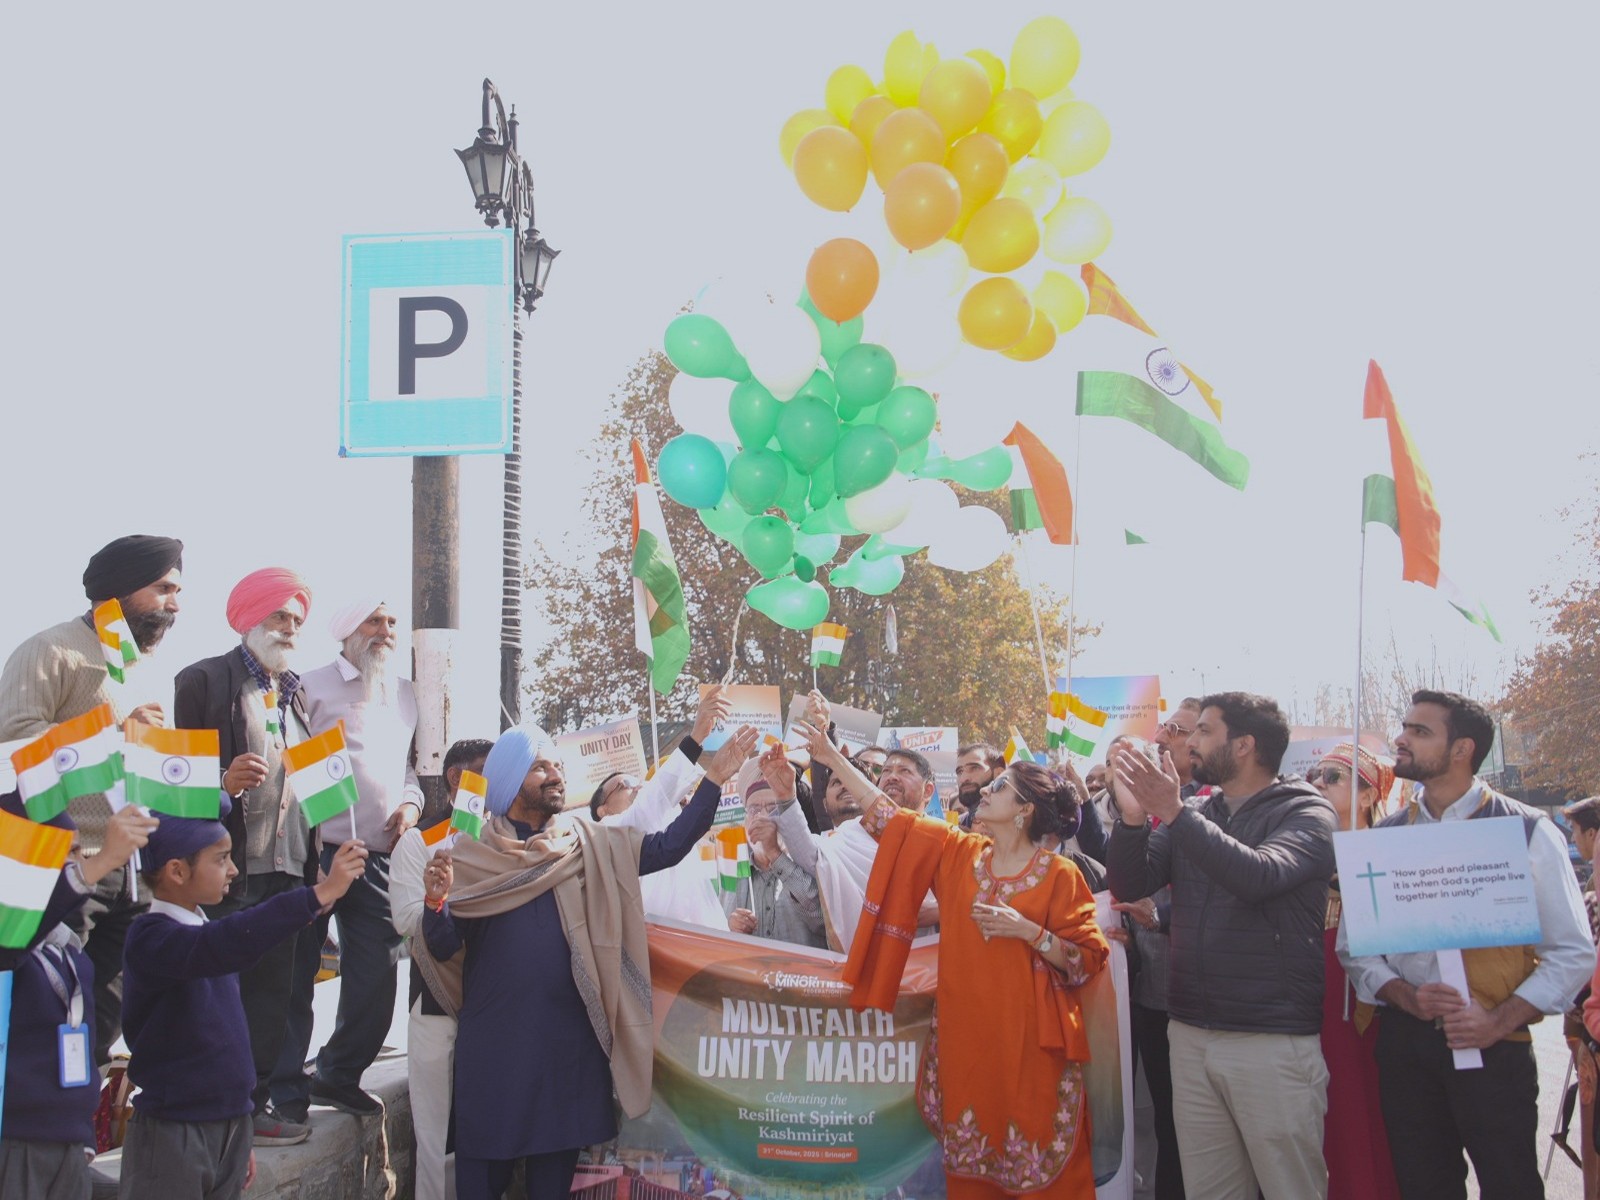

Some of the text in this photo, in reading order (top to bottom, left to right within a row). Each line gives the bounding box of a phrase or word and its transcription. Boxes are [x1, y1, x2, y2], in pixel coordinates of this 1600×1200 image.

[398, 296, 468, 395] P
[604, 725, 630, 736] National
[905, 732, 940, 747] UNITY
[580, 733, 631, 756] UNITY DAY
[1419, 866, 1445, 878] good
[1447, 864, 1465, 874] and
[1467, 861, 1510, 875] pleasant
[1402, 881, 1410, 889] is
[1412, 879, 1439, 888] when
[1441, 876, 1470, 886] God's
[1472, 873, 1506, 887] people
[1508, 871, 1525, 881] live
[1395, 890, 1438, 902] together
[1440, 889, 1449, 898] in
[722, 997, 895, 1037] MULTIFAITH
[698, 1036, 916, 1083] UNITY MARCH
[765, 1092, 848, 1107] Celebrating the
[738, 1107, 876, 1128] Resilient Spirit of
[759, 1126, 854, 1145] Kashmiriyat
[776, 1149, 802, 1158] October,
[825, 1150, 852, 1159] Srinagar
